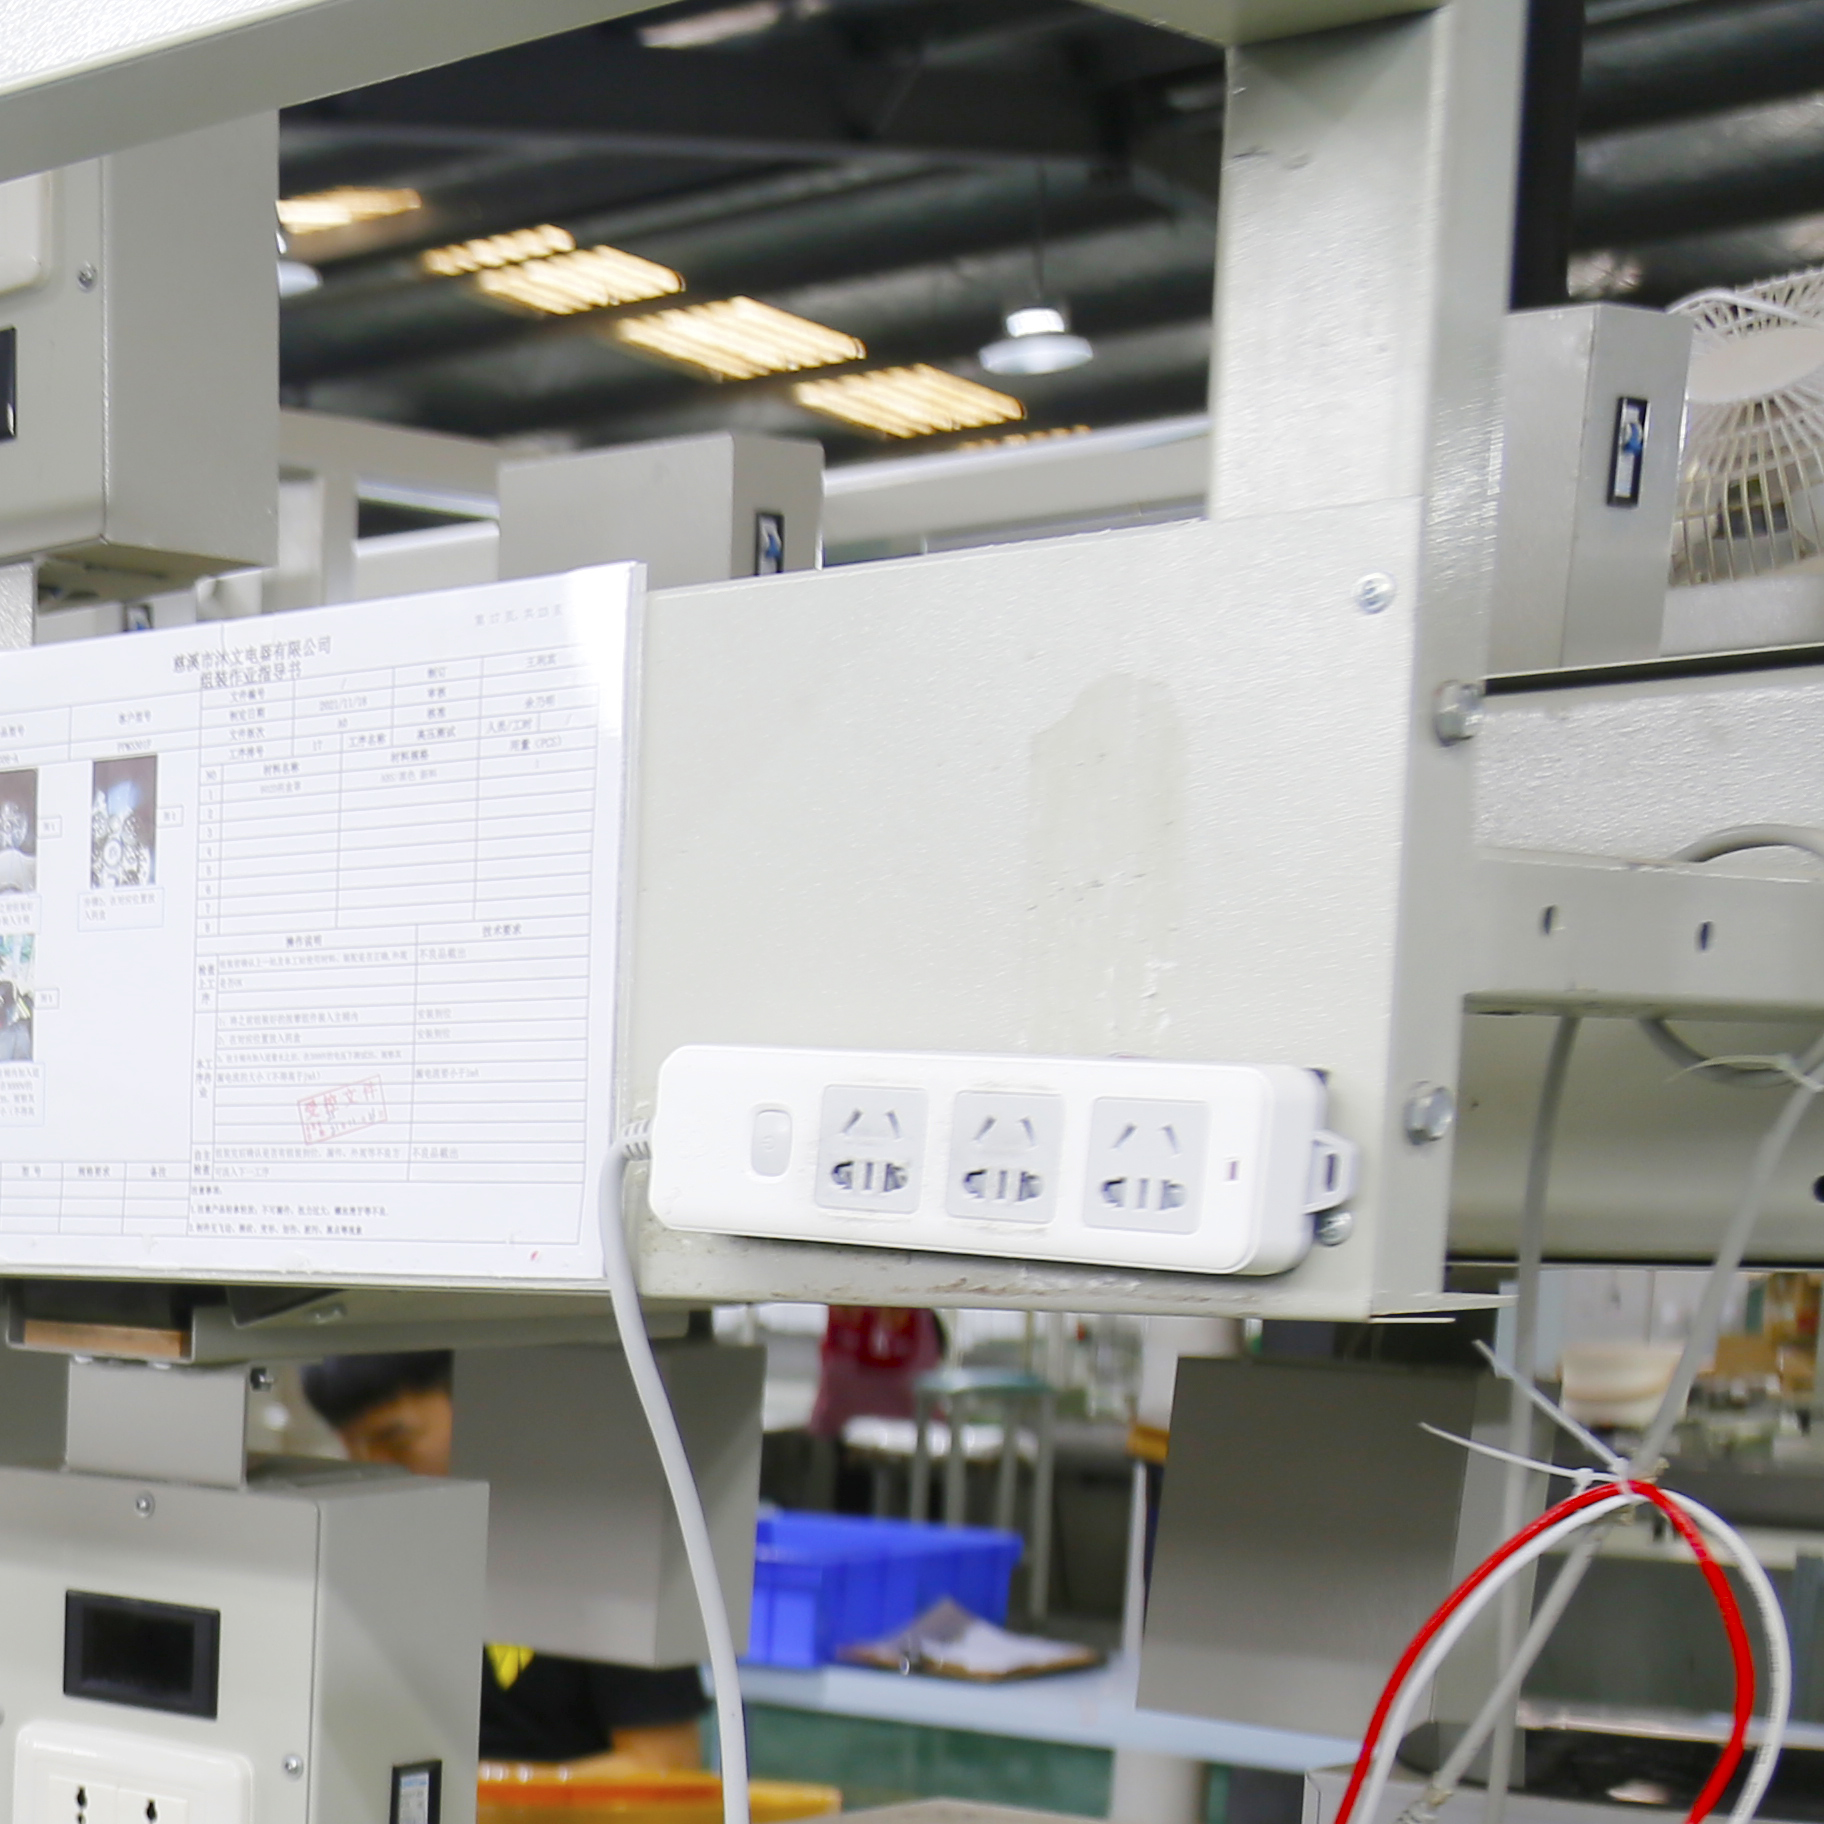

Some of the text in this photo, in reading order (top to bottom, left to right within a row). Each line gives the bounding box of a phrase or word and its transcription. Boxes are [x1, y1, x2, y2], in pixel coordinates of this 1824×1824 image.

[201, 662, 302, 690] 组装作业指导书
[482, 923, 522, 938] 技术要求
